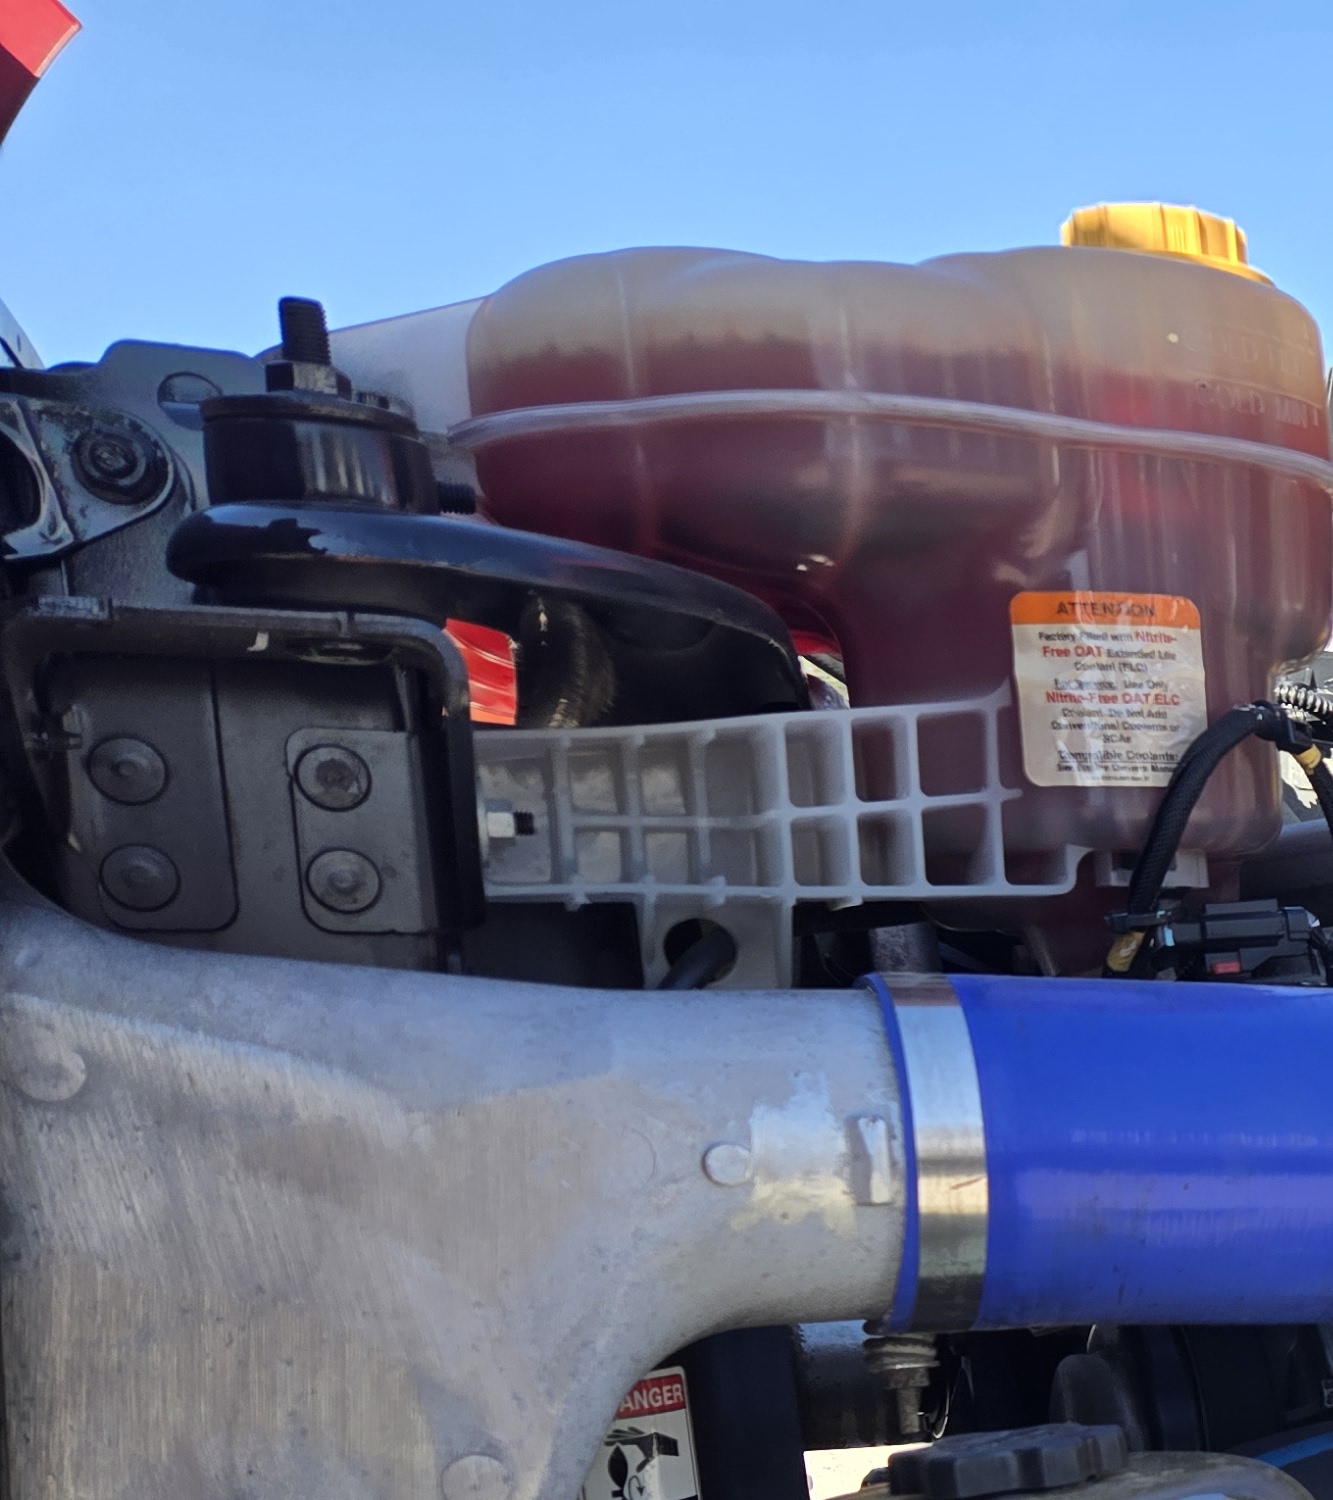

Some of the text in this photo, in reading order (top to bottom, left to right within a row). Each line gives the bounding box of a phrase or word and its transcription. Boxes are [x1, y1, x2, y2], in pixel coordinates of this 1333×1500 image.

[1056, 601, 1156, 617] ATTENTION
[1042, 645, 1071, 658] Free
[1154, 693, 1181, 706] ELC
[619, 1384, 685, 1412] ANGER
